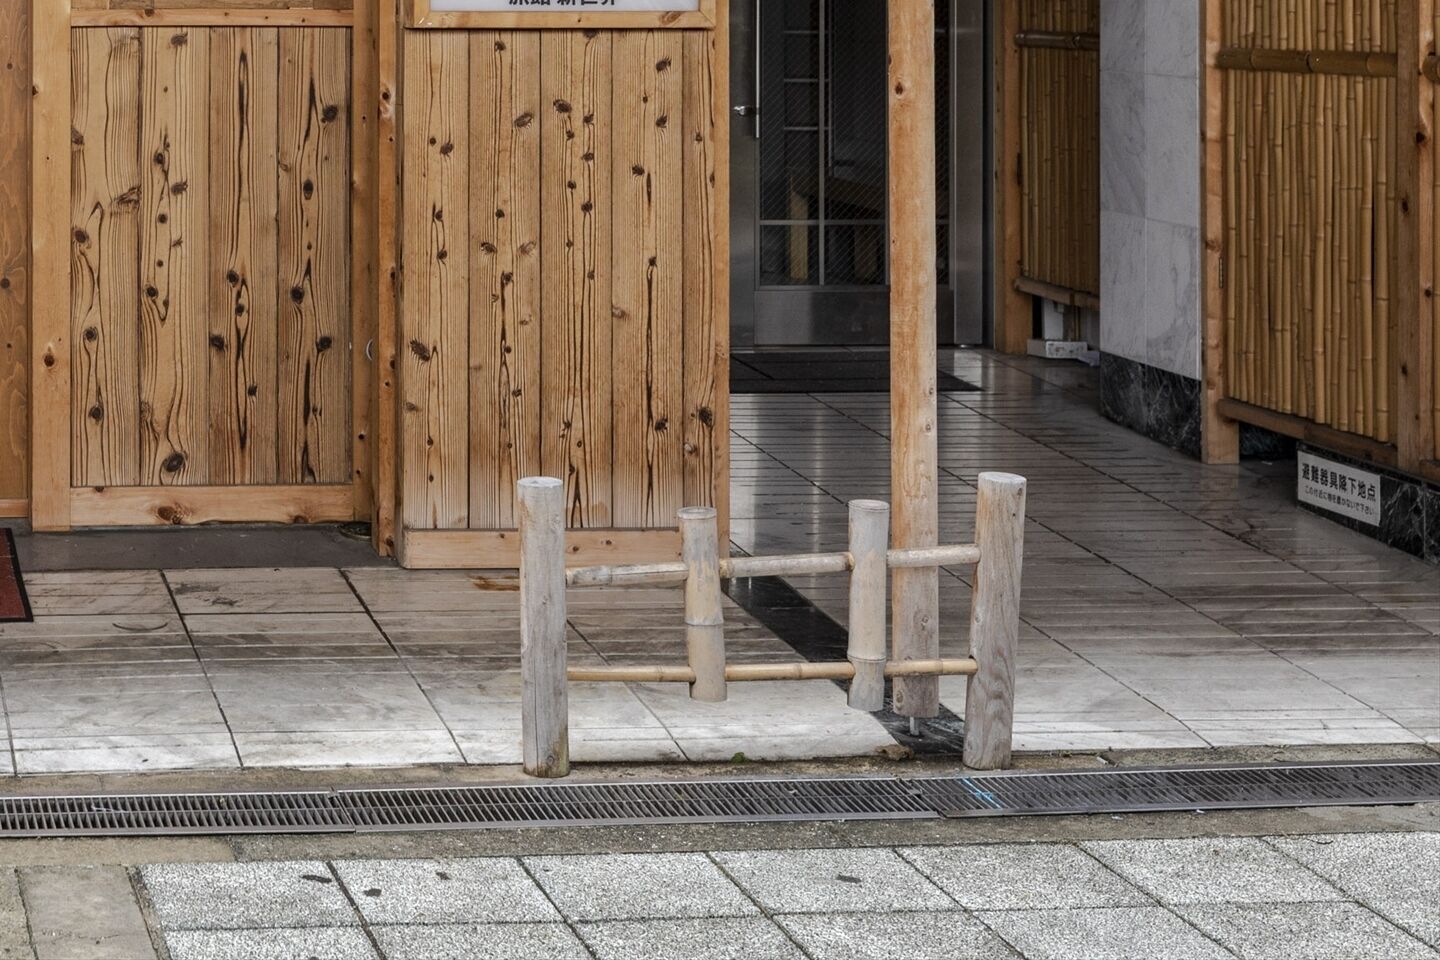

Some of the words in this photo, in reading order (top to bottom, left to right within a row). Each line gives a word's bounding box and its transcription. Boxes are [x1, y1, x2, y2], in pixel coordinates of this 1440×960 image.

[1302, 463, 1377, 503] 避難器具降下地点
